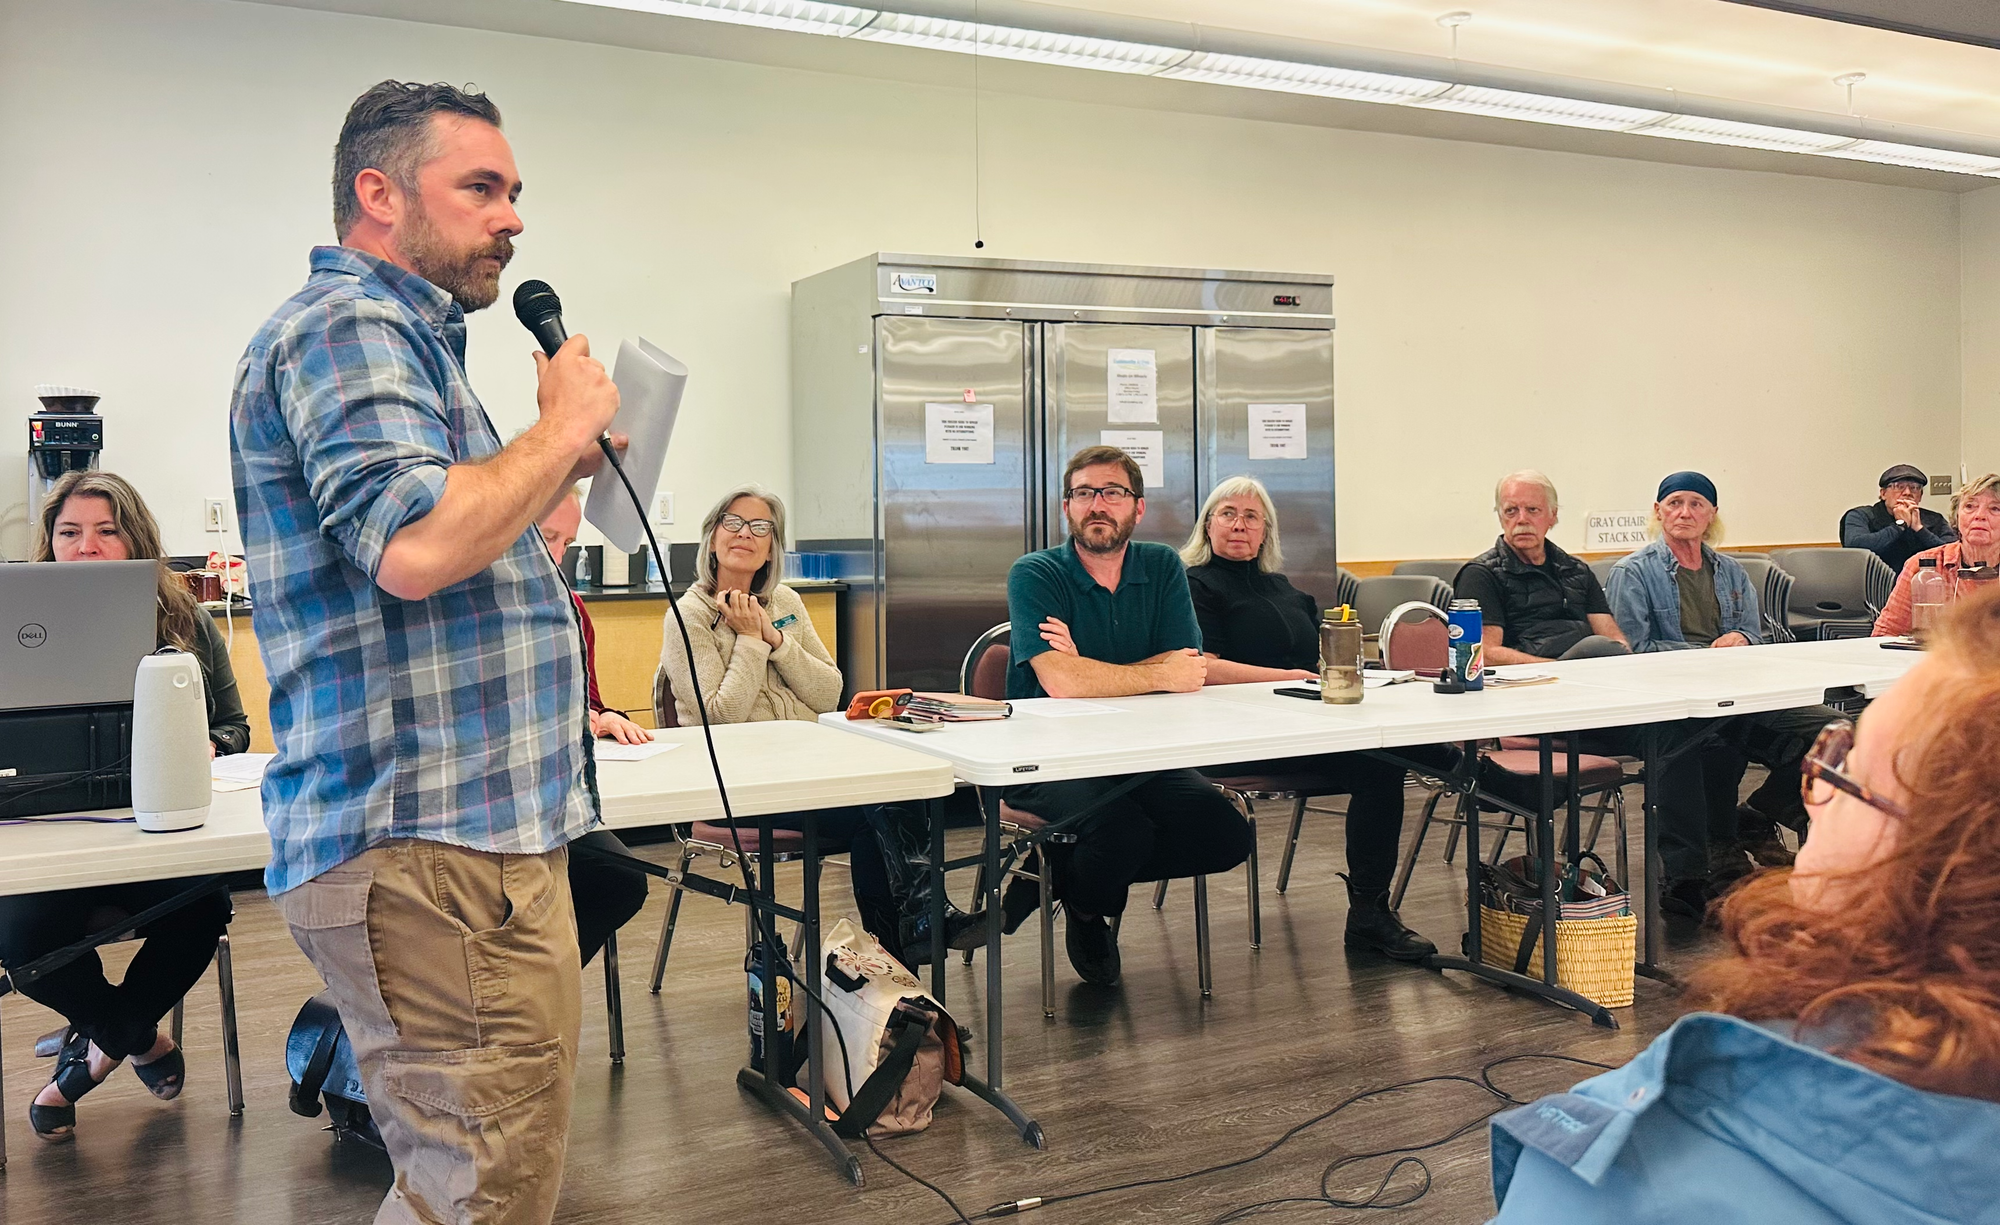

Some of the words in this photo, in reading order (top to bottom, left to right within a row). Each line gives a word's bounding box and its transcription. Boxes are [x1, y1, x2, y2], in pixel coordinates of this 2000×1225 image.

[1590, 516, 1615, 528] GRAY
[1616, 515, 1648, 528] CHAIR
[1598, 531, 1629, 543] STACK
[1630, 531, 1646, 542] SIX
